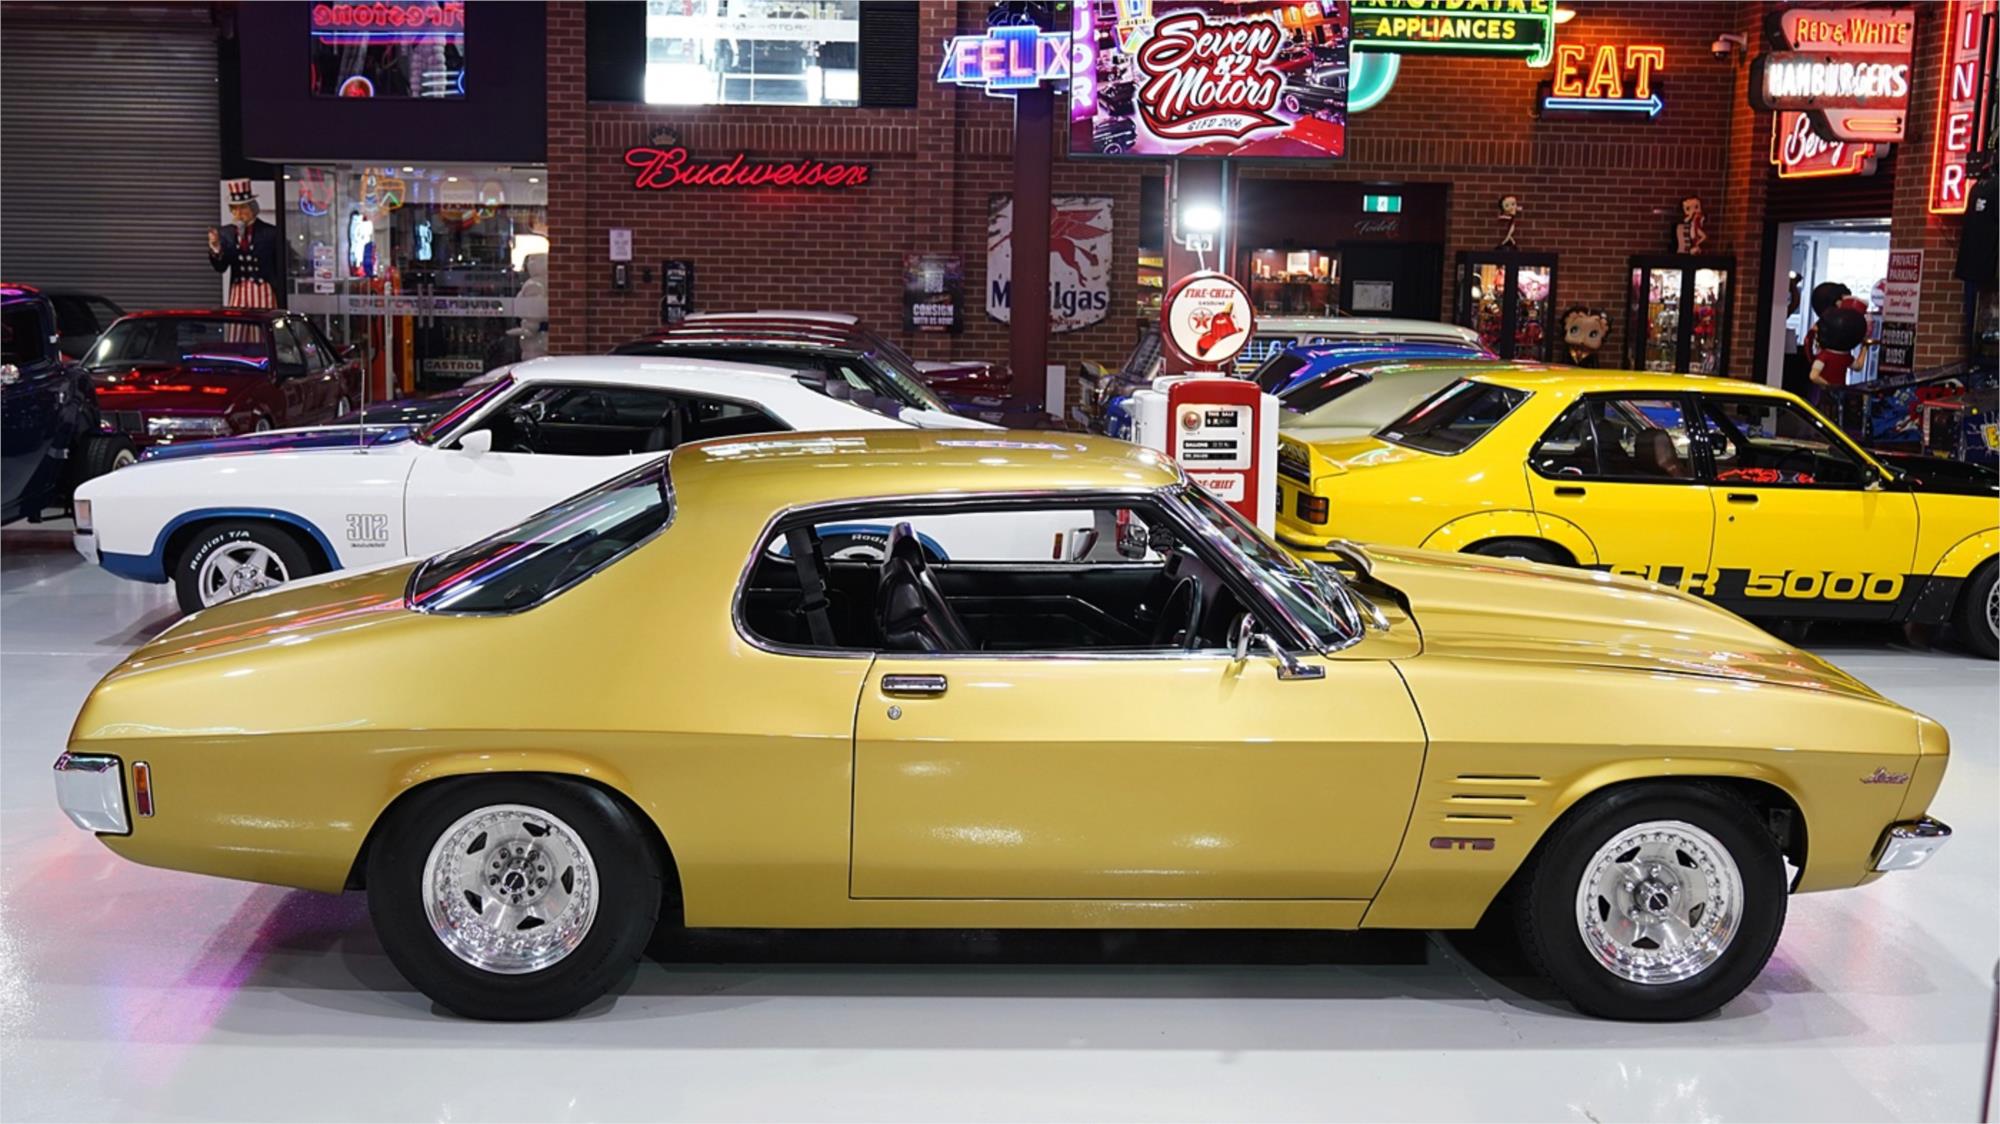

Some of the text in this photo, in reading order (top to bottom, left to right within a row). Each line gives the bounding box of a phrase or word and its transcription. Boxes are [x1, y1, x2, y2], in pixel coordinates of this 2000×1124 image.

[1376, 17, 1516, 39] APPLIANCES
[1797, 18, 1829, 42] RED
[1848, 18, 1906, 44] WHITE
[956, 38, 1071, 78] FELIX
[1144, 19, 1273, 71] Seven
[1213, 55, 1252, 77] 82
[1554, 45, 1665, 97] EAT
[1767, 62, 1908, 97] HAMBURGERS
[1146, 68, 1275, 120] Motors
[624, 148, 868, 189] Budweiser
[1891, 254, 1919, 267] PRIVATE
[1888, 269, 1917, 282] PARKING
[913, 303, 954, 316] CONSIGN
[991, 281, 1107, 317] Mlgas
[425, 361, 480, 370] CASTROL
[228, 530, 250, 538] T/A
[346, 514, 389, 541] 302
[1744, 569, 1904, 601] 5000
